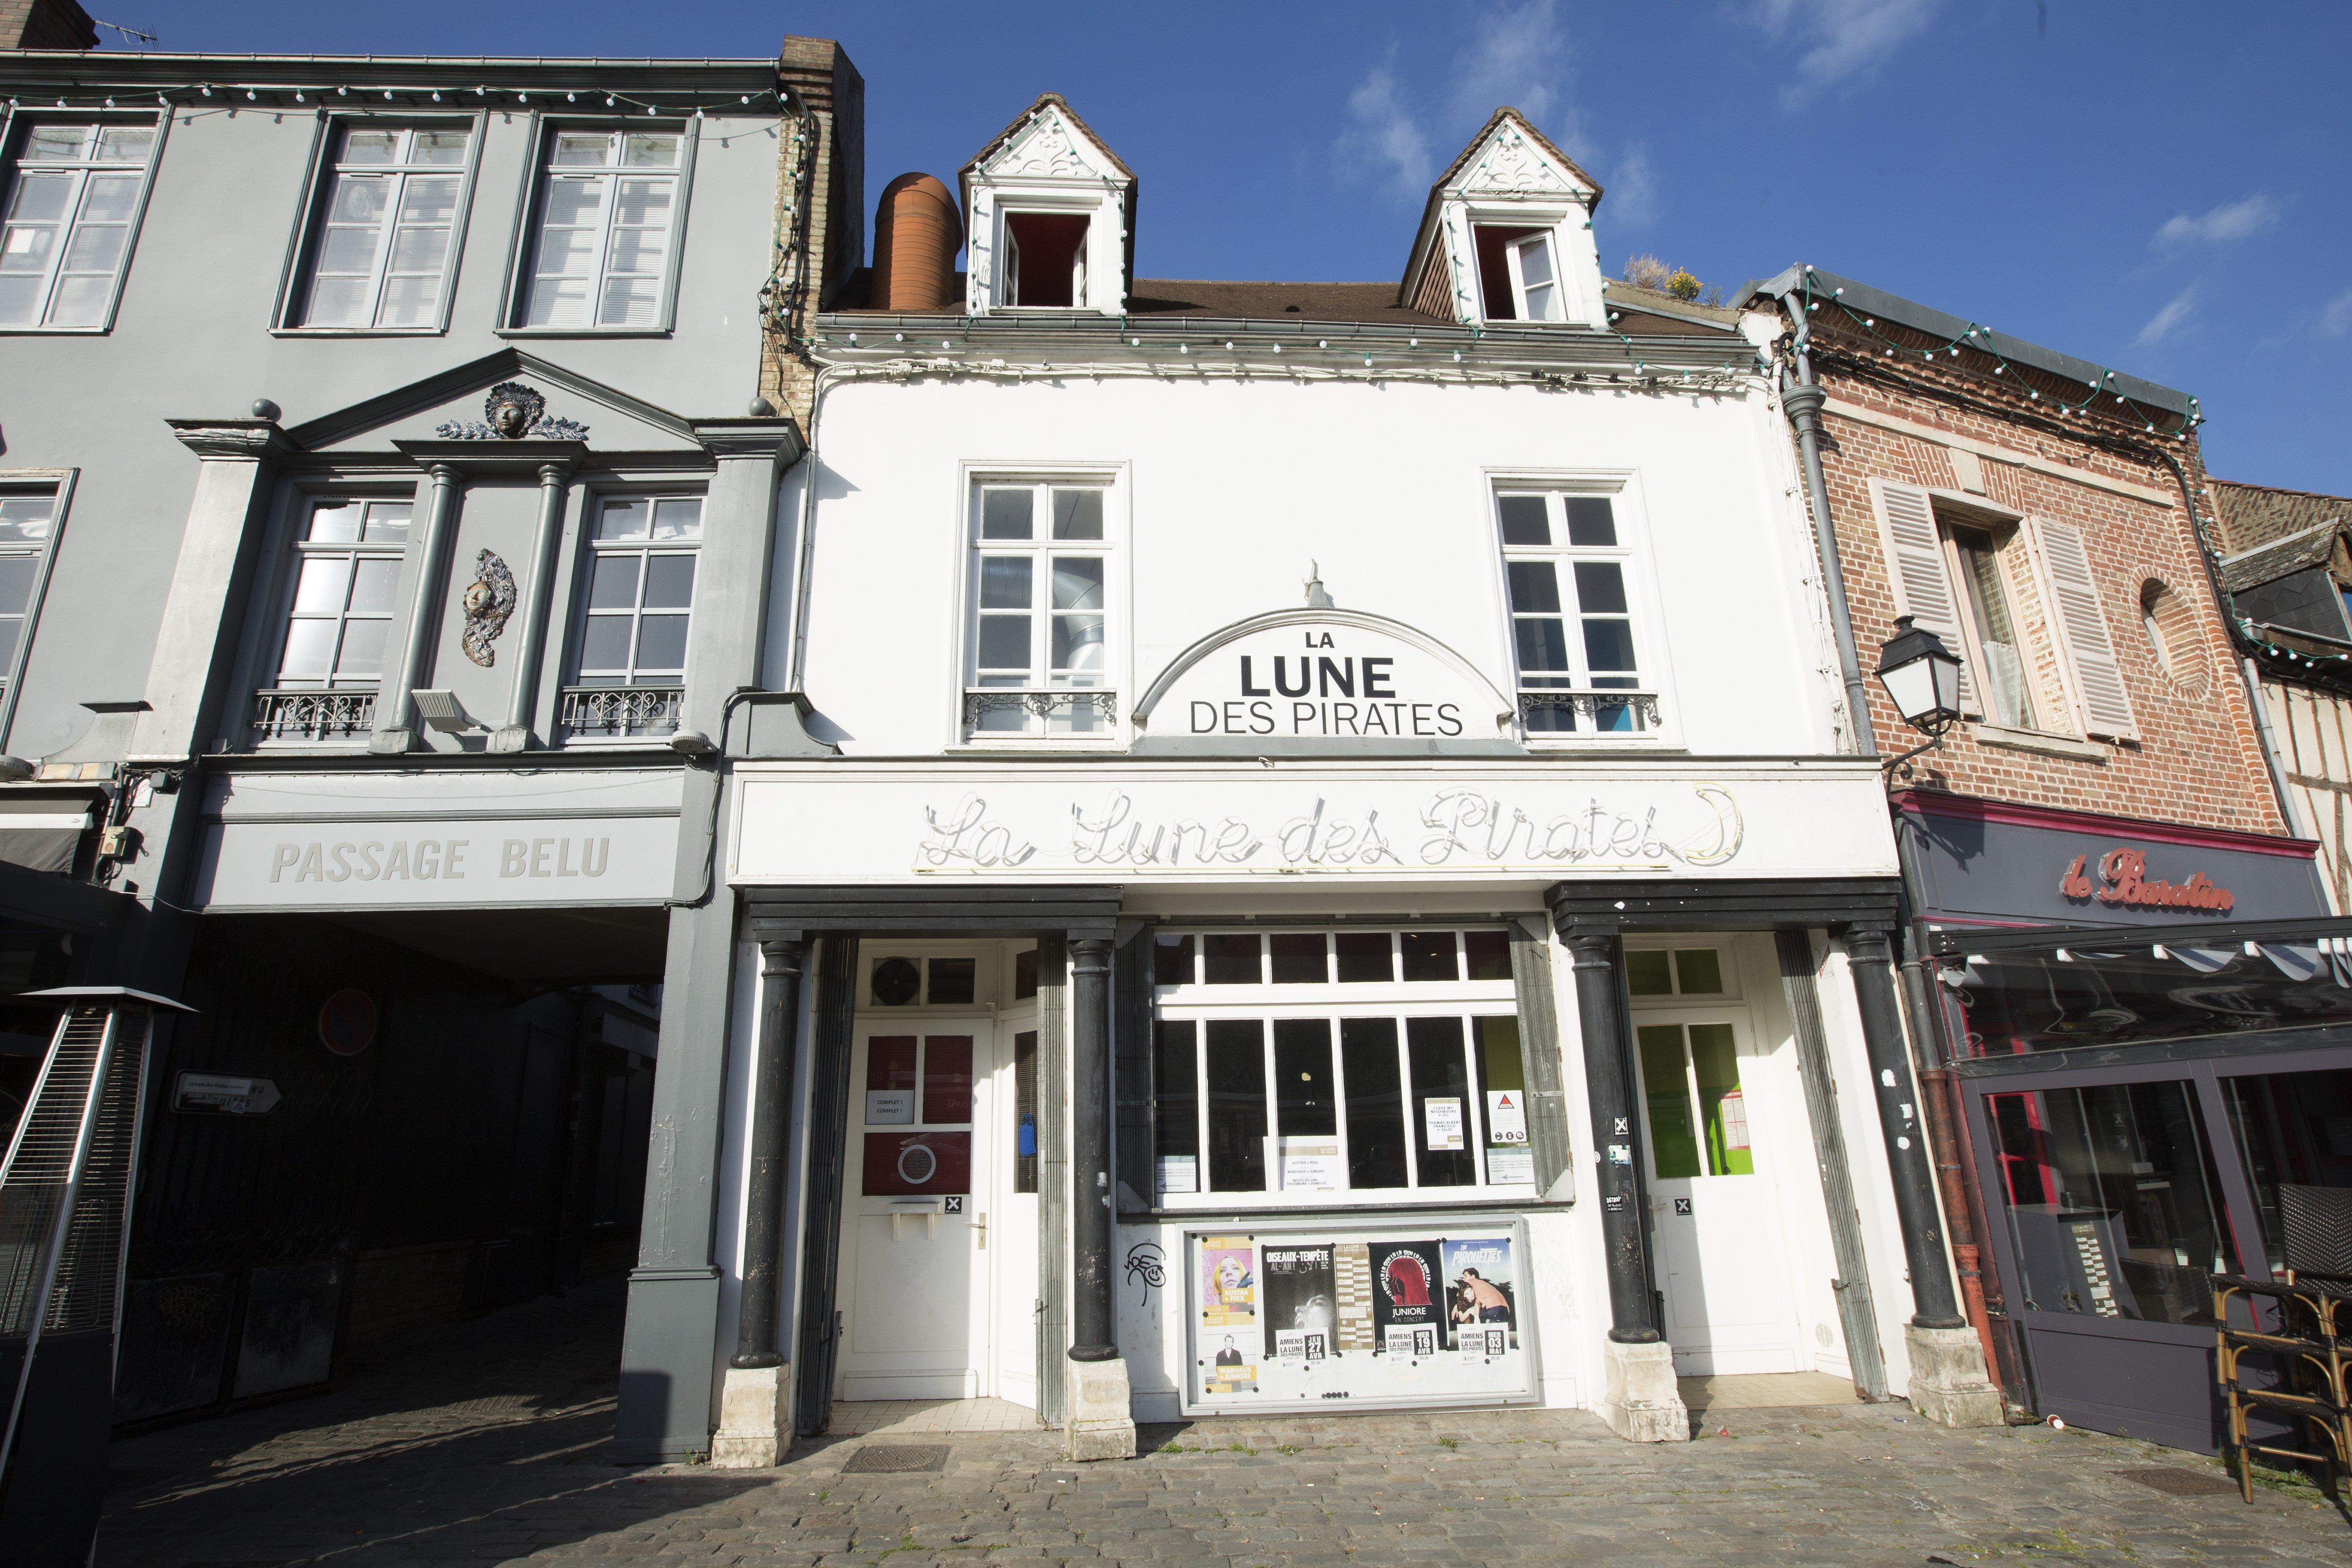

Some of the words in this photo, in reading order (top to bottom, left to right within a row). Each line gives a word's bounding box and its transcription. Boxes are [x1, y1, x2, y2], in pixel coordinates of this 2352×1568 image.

[1305, 632, 1335, 648] LA
[1240, 655, 1396, 698] LUNE
[1191, 701, 1275, 734] DES
[1294, 702, 1463, 736] PIRATES
[918, 791, 1031, 862] La
[1068, 788, 1261, 862] Lune
[1278, 791, 1399, 861] des
[1417, 786, 1683, 860] Pirates
[270, 839, 469, 883] PASSAGE
[500, 837, 610, 878] BELU
[2099, 847, 2235, 910] Baratin
[1266, 1248, 1329, 1262] OISEAUX-TEMPÊTE
[1451, 1247, 1503, 1266] PIROUETTES
[1392, 1307, 1426, 1318] JUNIORE
[1308, 1342, 1321, 1352] 27
[1417, 1338, 1430, 1348] 19
[1488, 1338, 1501, 1348] 03
